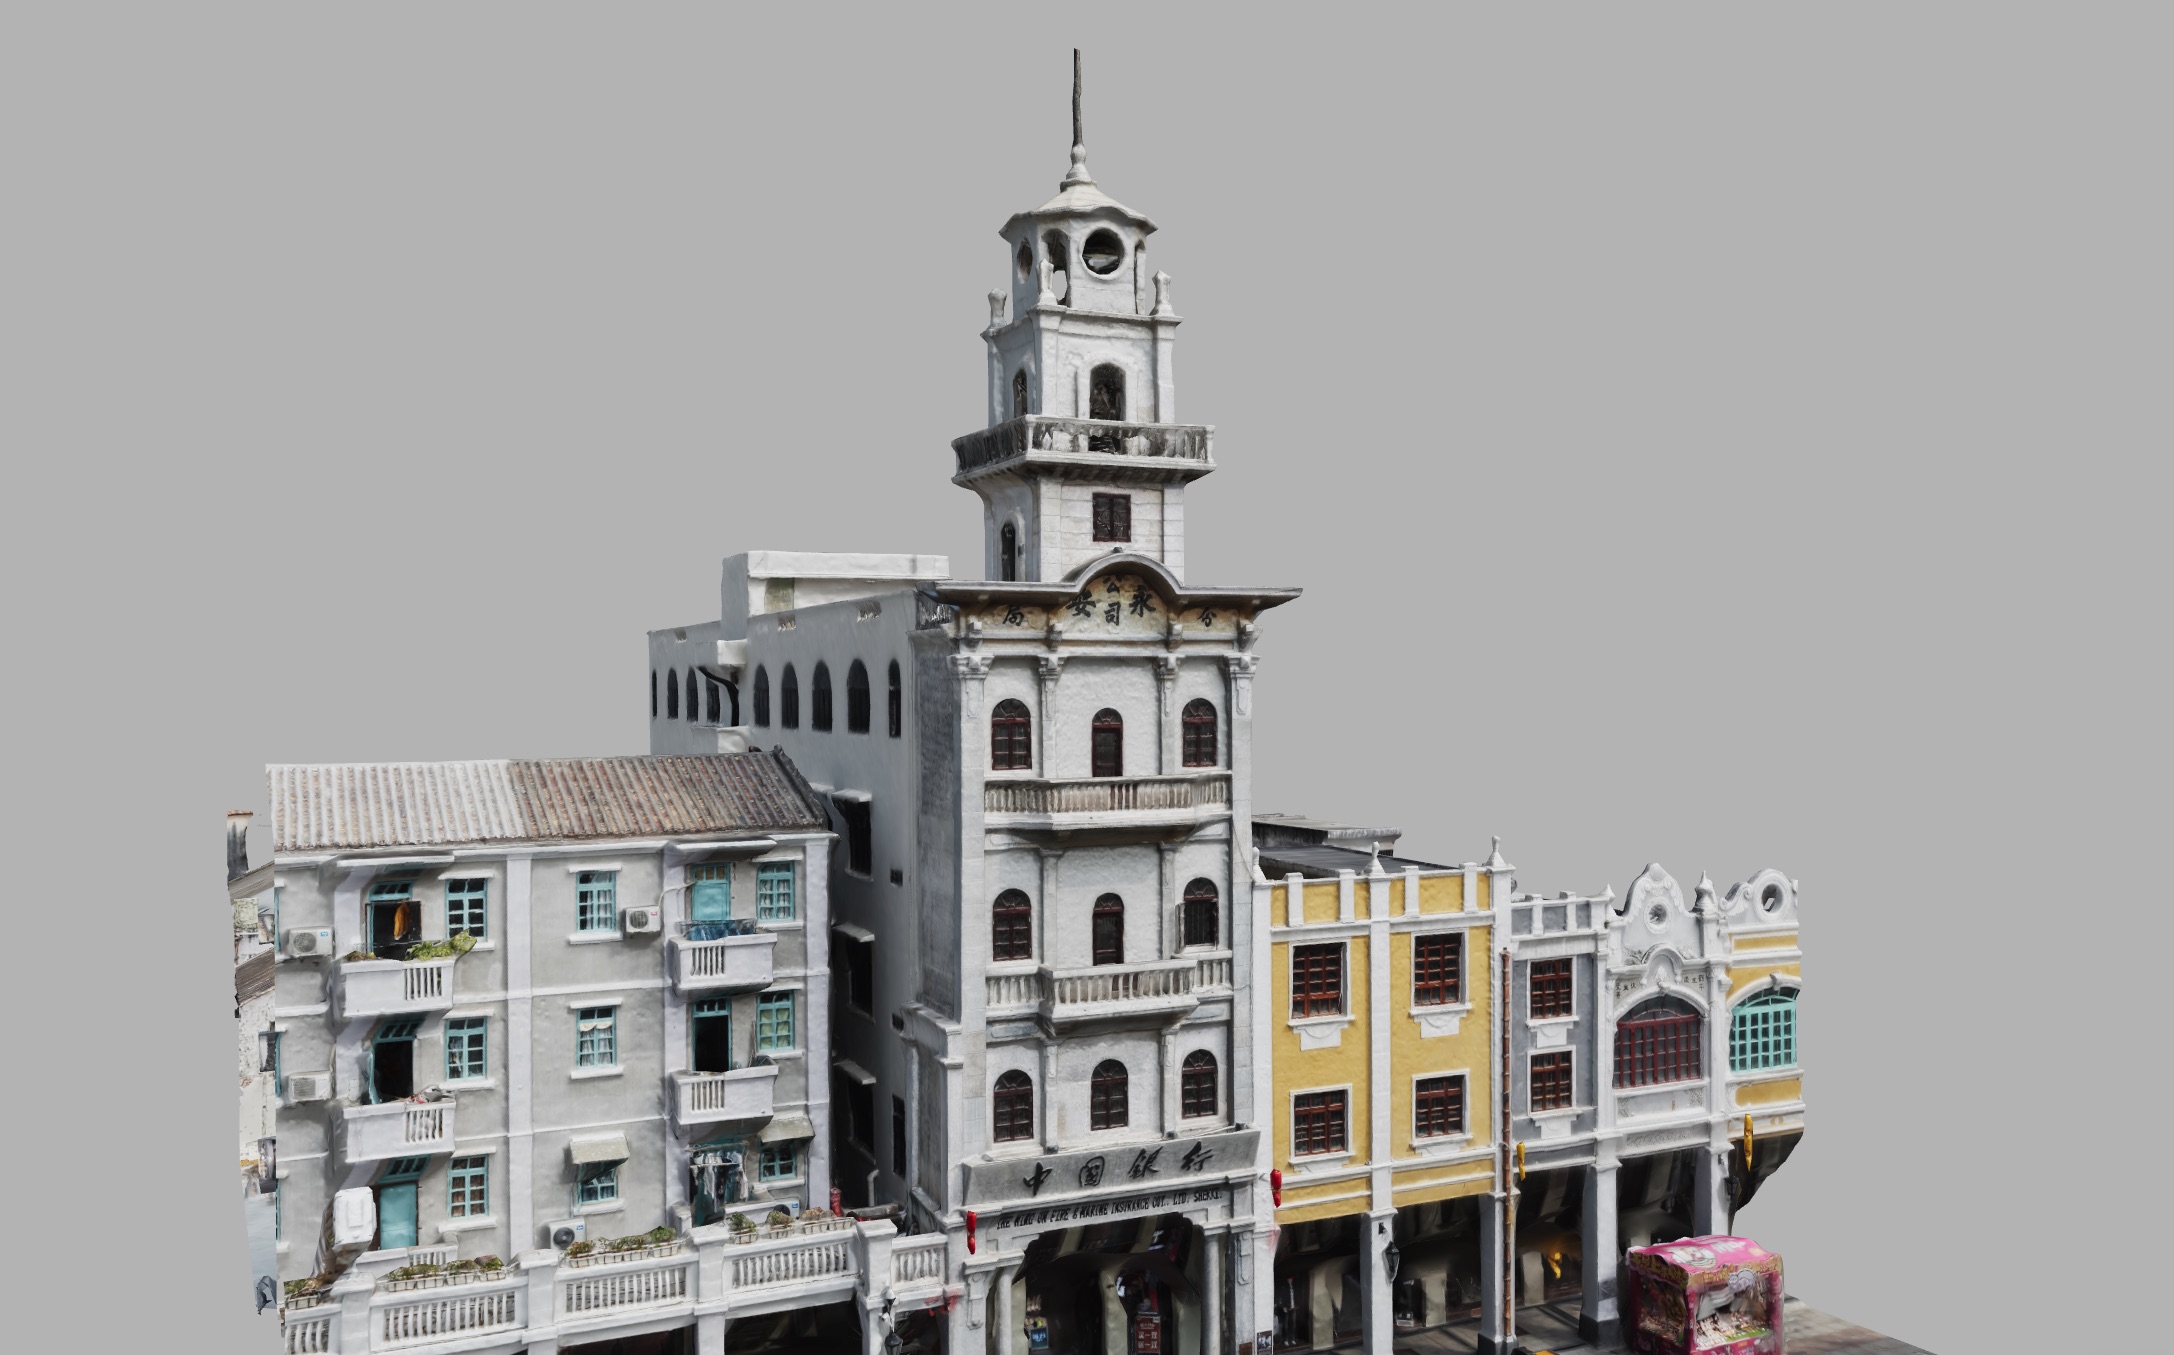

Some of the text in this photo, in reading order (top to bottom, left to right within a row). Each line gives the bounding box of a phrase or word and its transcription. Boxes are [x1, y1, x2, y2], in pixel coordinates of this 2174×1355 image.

[1003, 607, 1025, 627] 局
[1197, 606, 1217, 627] 分
[1023, 1141, 1215, 1196] 中國銀行
[1014, 1211, 1036, 1227] WING
[1037, 1209, 1050, 1224] ON
[1050, 1207, 1071, 1222] FIRE
[1080, 1202, 1109, 1218] MARINE
[1111, 1198, 1150, 1214] INSURANCE
